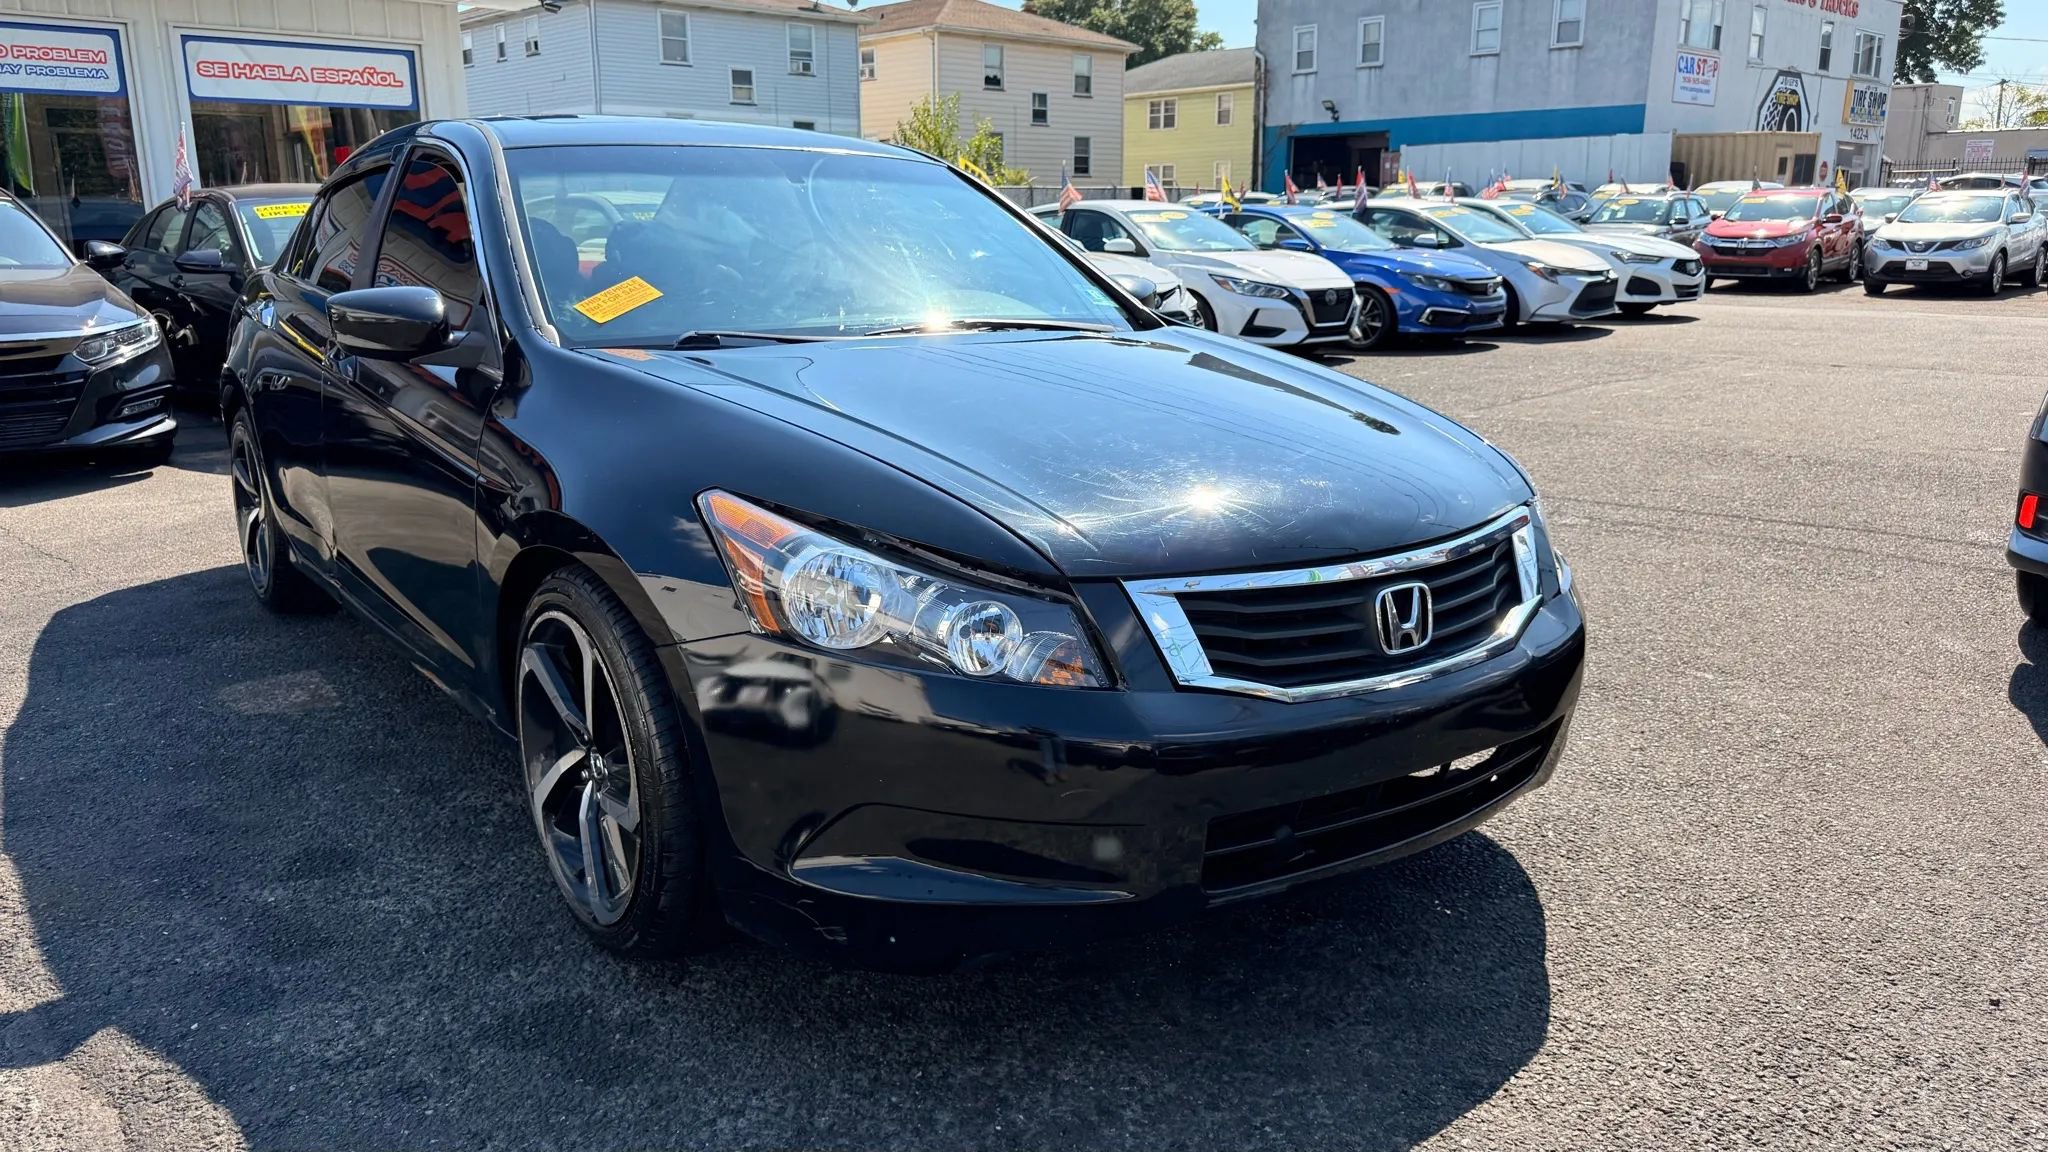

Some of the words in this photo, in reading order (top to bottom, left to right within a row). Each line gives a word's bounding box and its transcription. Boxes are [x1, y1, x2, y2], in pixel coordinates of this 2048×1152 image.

[11, 45, 107, 64] PROBLEM
[25, 64, 109, 79] PROBLEMA
[197, 61, 230, 78] SE
[231, 63, 308, 82] HABLA
[311, 67, 404, 87] ESPAÑOL
[1678, 55, 1695, 74] CAR
[1852, 89, 1867, 108] TIRE
[1868, 91, 1887, 110] SHOP
